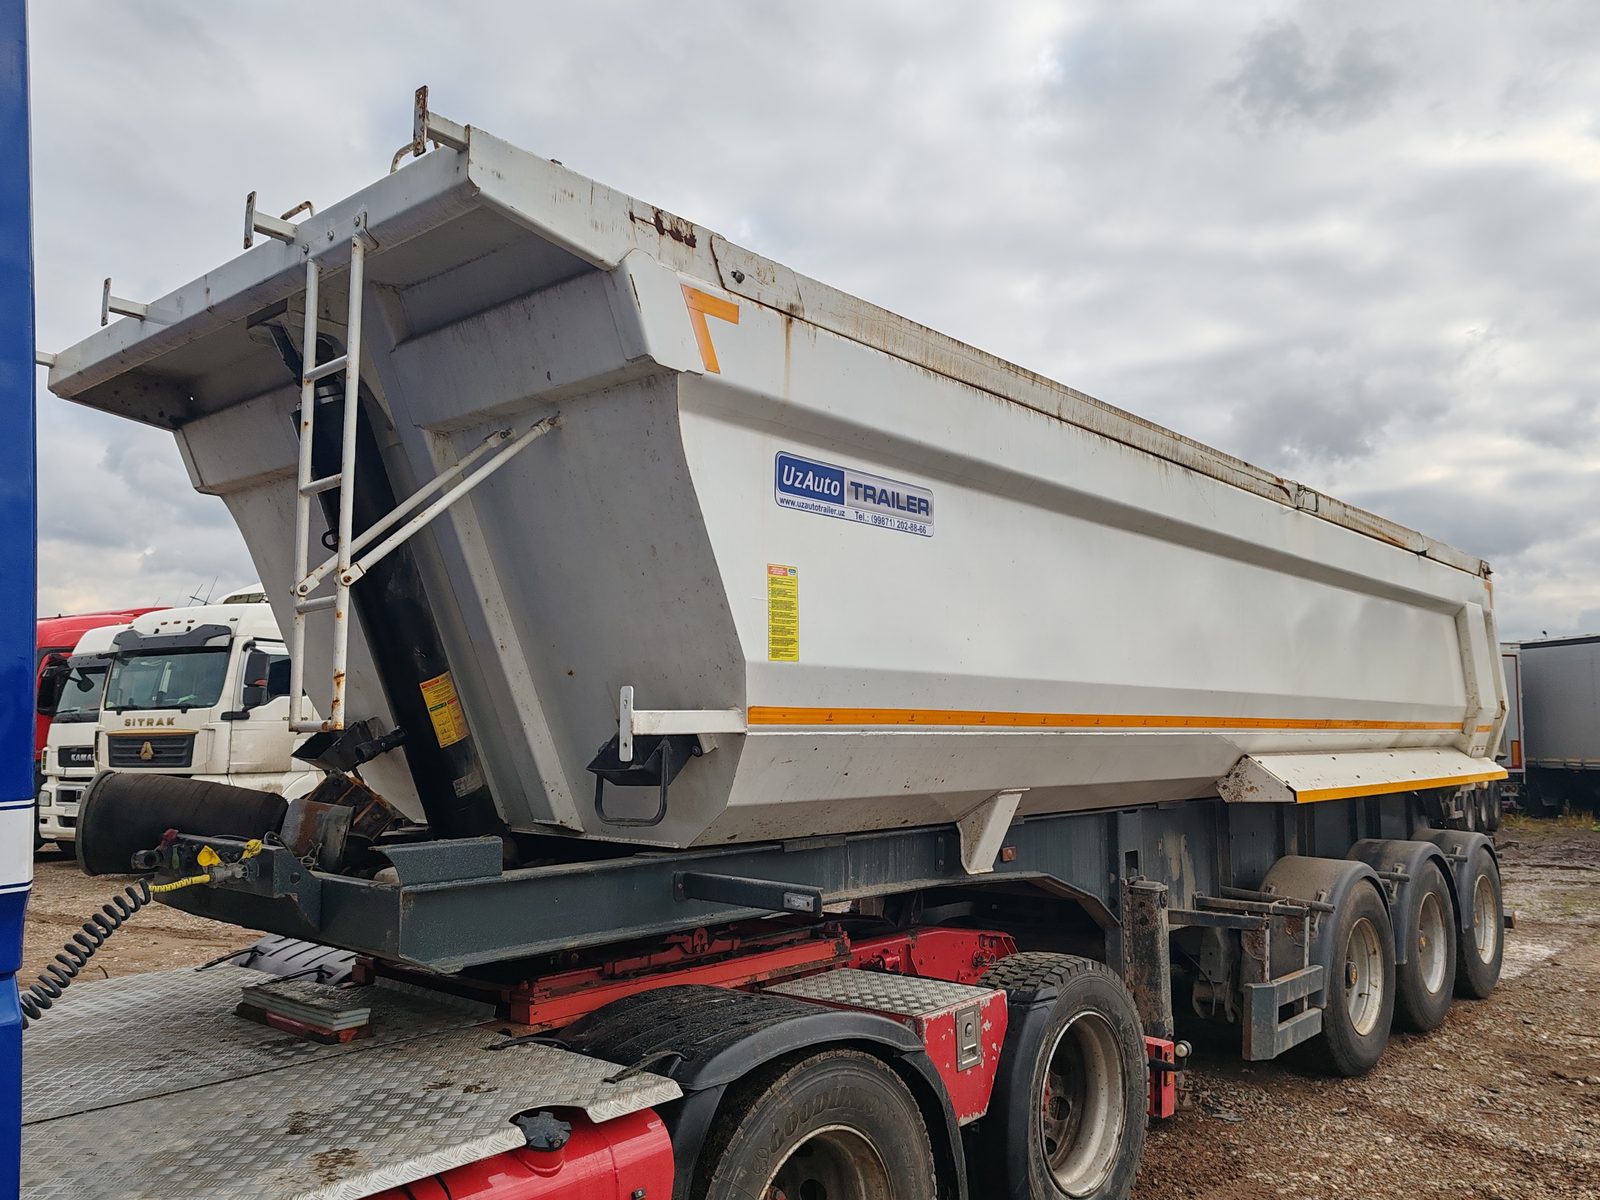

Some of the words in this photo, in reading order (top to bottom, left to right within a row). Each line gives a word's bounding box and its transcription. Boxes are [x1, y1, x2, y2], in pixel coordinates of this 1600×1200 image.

[782, 464, 841, 497] UzAuto
[850, 481, 930, 517] TRAILER
[779, 497, 846, 518] www.uzautotrailer.uz
[124, 717, 176, 727] SITRAK
